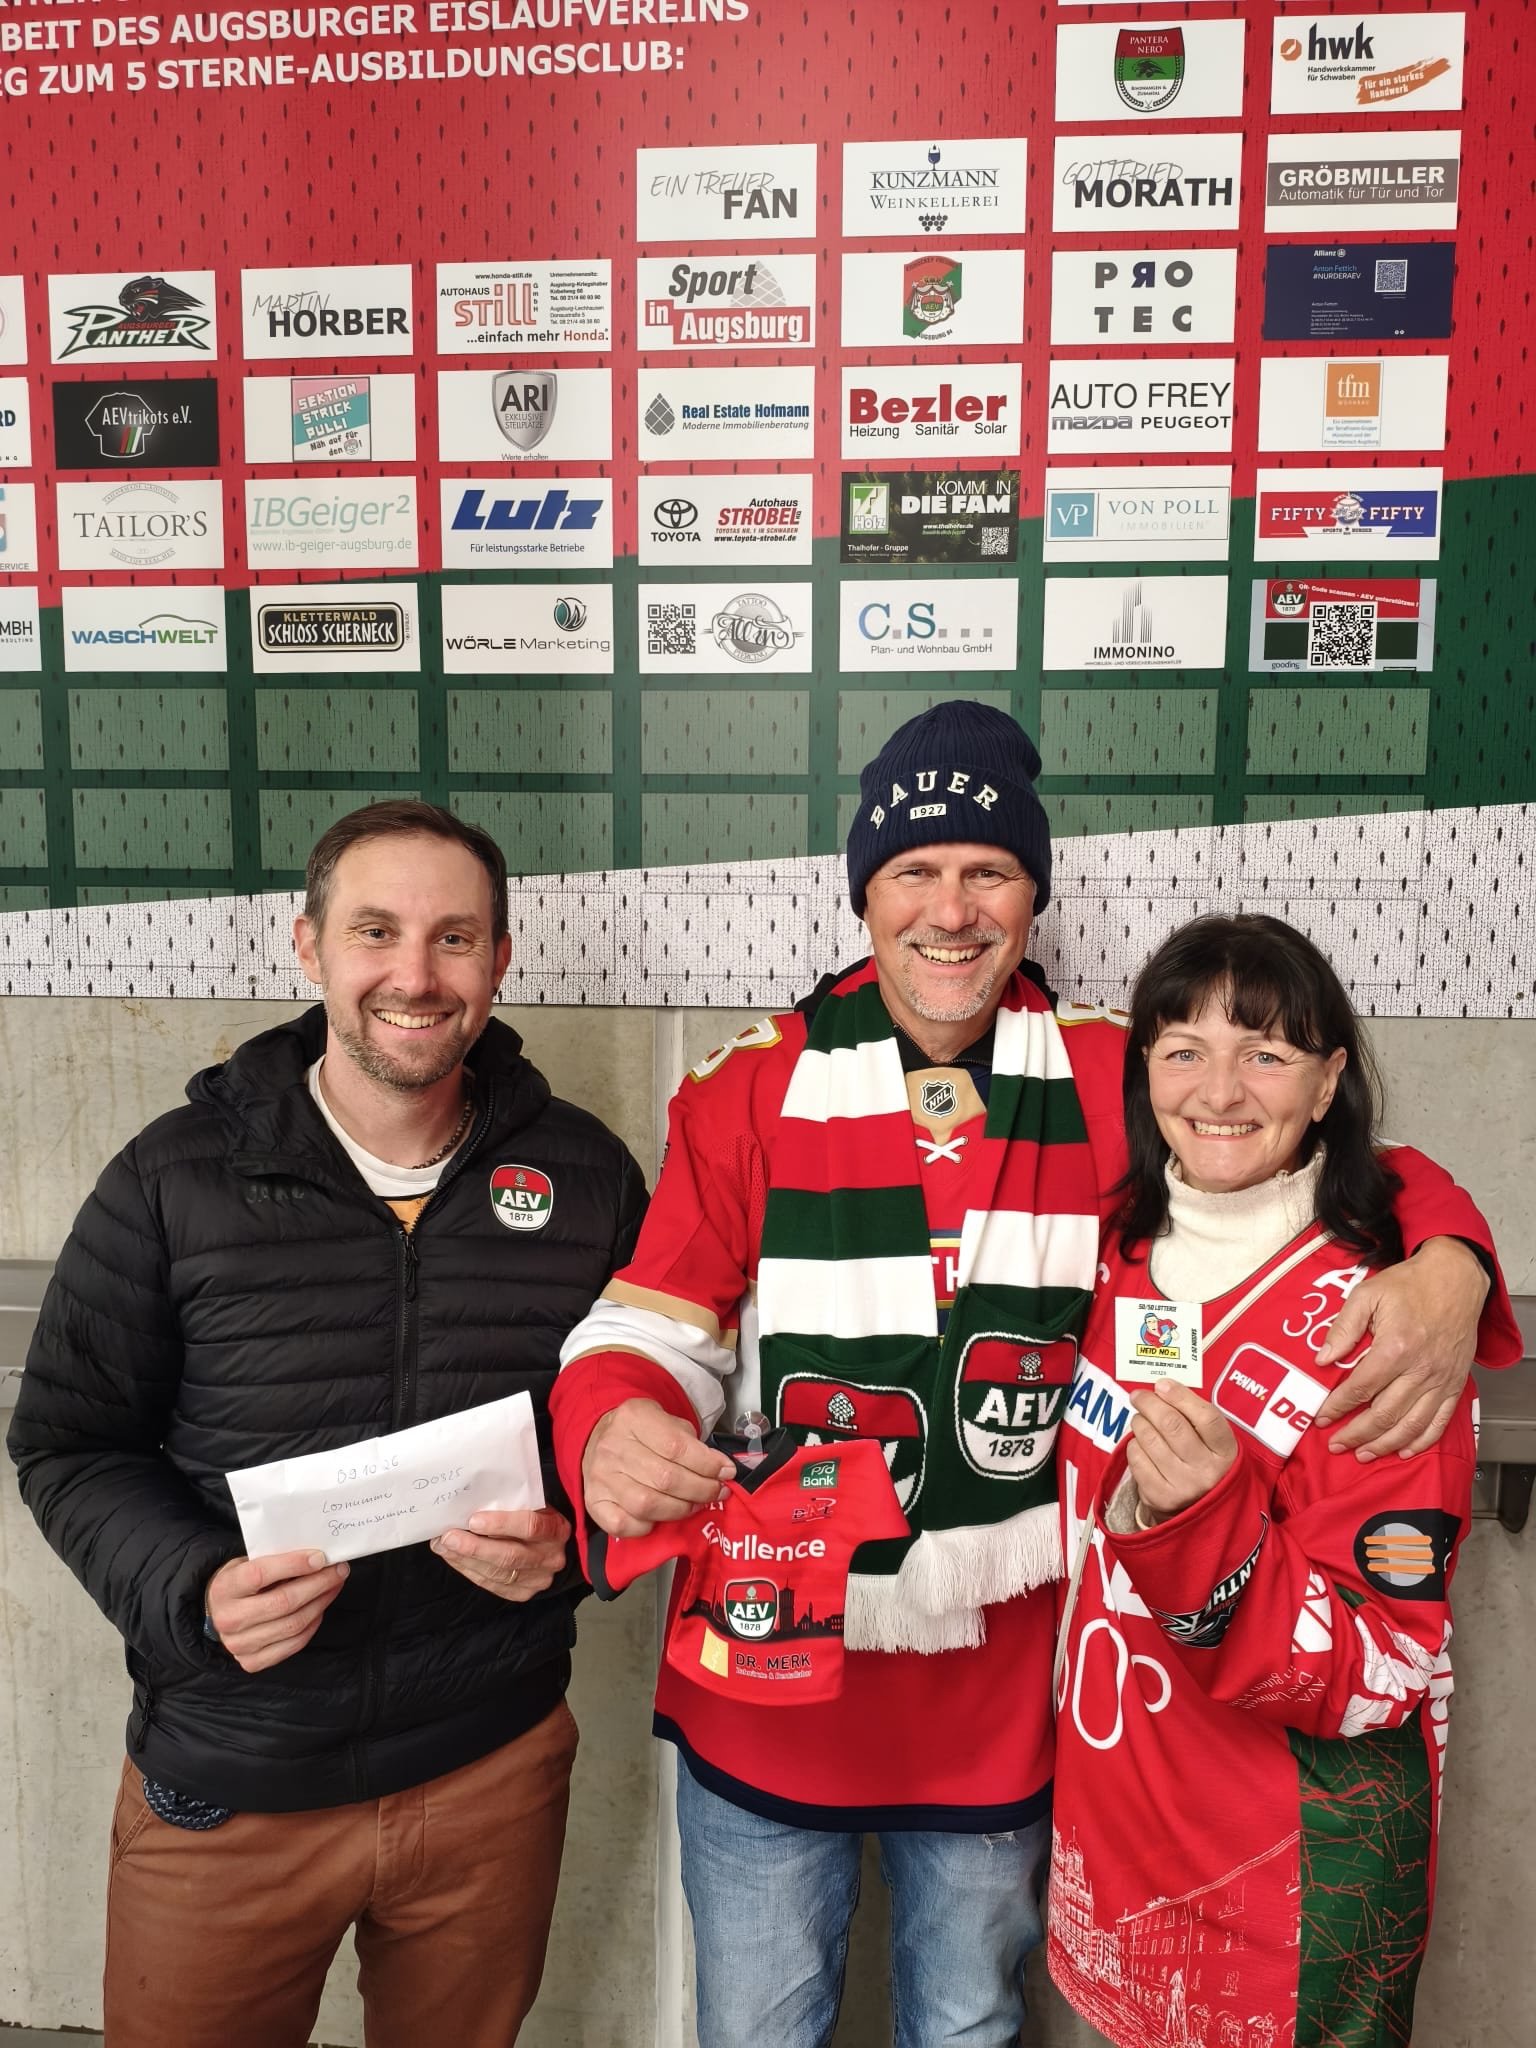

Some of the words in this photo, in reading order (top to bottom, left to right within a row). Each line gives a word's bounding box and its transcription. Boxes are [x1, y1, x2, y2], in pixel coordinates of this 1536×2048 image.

[92, 15, 161, 47] DES
[170, 6, 417, 44] AUGSBURGER
[430, 0, 748, 33] EISLAUFVEREINS
[1130, 35, 1169, 45] PANTERA
[1308, 22, 1374, 61] hwk
[1137, 45, 1163, 54] NERO
[39, 63, 114, 95] ZUM
[127, 61, 147, 91] 5
[157, 41, 686, 90] STERNE-AUSBILDUNGSCLUB:
[1308, 65, 1376, 73] Handwerkskammer
[1320, 73, 1355, 81] Schwaben
[1364, 79, 1377, 89] für
[1379, 77, 1391, 87] ein
[1393, 71, 1425, 84] starkes
[1370, 83, 1408, 99] Handwerk
[871, 170, 998, 189] KUNZMANN
[1062, 158, 1183, 186] GOTTFRIED
[1279, 164, 1444, 187] GRÖBMILLER
[650, 174, 686, 197] EIN
[695, 170, 775, 196] TREUER
[869, 193, 999, 209] WEINKELLEREI
[1075, 177, 1232, 209] MORATH
[1279, 187, 1343, 201] Automatik
[1347, 187, 1365, 199] für
[1369, 186, 1390, 199] Tür
[1395, 186, 1419, 198] und
[1424, 185, 1444, 198] Tor
[723, 188, 798, 220] FAN
[1314, 249, 1336, 257] Allianz
[668, 261, 758, 303] Sport
[1313, 272, 1361, 280] #NURDERAEV
[440, 287, 490, 297] AUTOHAUS
[252, 290, 330, 317] MARTIN
[269, 307, 410, 338] HORBER
[649, 301, 669, 325] in
[680, 310, 804, 343] Augsburg
[1094, 305, 1193, 333] TEC
[58, 305, 211, 359] PANTHER
[527, 331, 560, 342] mehr
[1337, 373, 1370, 398] tfm
[298, 383, 357, 410] SEKTION
[500, 384, 547, 411] ARI
[1050, 383, 1138, 410] AUTO
[1148, 382, 1231, 409] FREY
[302, 401, 352, 424] STRICK
[682, 404, 710, 419] Real
[714, 404, 751, 419] Estate
[755, 403, 810, 418] Hofmann
[849, 384, 1007, 425] Bezler
[102, 407, 169, 426] AEVtrikots
[172, 407, 192, 424] e.V.
[505, 413, 543, 421] EXKLUSIVE
[1140, 415, 1232, 429] PEUGEOT
[305, 417, 348, 439] PULLI
[682, 421, 719, 430] Moderne
[722, 420, 810, 431] Immobilienberatung
[849, 424, 900, 439] Heizung
[915, 422, 960, 436] Sanitär
[974, 421, 1007, 435] Solar
[310, 439, 326, 451] Näh
[345, 431, 358, 439] für
[328, 447, 343, 456] den
[936, 481, 985, 495] KOMM
[997, 481, 1011, 494] IN
[451, 489, 604, 530] Lutz
[749, 498, 798, 507] Autohaus
[901, 495, 947, 514] DIE
[951, 495, 1010, 514] FAM
[718, 508, 799, 525] STROBEL
[1056, 504, 1089, 526] VP
[1108, 500, 1154, 515] VON
[1164, 499, 1219, 514] POLL
[1271, 507, 1326, 521] FIFTY
[1370, 507, 1425, 520] FIFTY
[854, 515, 886, 529] Holz
[1120, 520, 1205, 531] IMMOBILIEN
[252, 538, 412, 553] www.ib-geiger-augsburg.de
[651, 532, 702, 542] TOYOTA
[714, 534, 796, 543] www.toyota-strobel.de
[470, 543, 484, 553] Für
[485, 543, 549, 555] leistungsstarke
[549, 543, 585, 553] Betriebe
[884, 545, 909, 553] Gruppe
[1277, 594, 1302, 604] AEV
[1360, 592, 1375, 601] AEV
[283, 611, 377, 622] KLETTERWALD
[71, 629, 218, 645] WASCHWELT
[268, 623, 319, 644] SCHLOSS
[322, 622, 395, 643] SCHERNECK
[445, 635, 516, 650] WÖRLE
[520, 637, 611, 653] Marketing
[871, 644, 895, 655] Plan-
[897, 644, 915, 654] und
[917, 643, 960, 654] Wohnbau
[962, 643, 993, 654] GmbH
[1094, 646, 1175, 659] IMMONINO
[1272, 660, 1300, 669] gooding
[870, 770, 999, 830] BAUER
[912, 805, 944, 817] 1927
[928, 1087, 950, 1110] NHL
[500, 1187, 542, 1210] AEV
[509, 1212, 534, 1222] 1878
[975, 1388, 1063, 1428] AEV
[988, 1436, 1035, 1458] 1878
[811, 1462, 836, 1476] psd
[803, 1475, 834, 1487] Bank
[732, 1602, 770, 1618] AEV
[740, 1622, 761, 1631] 1878
[736, 1653, 762, 1670] DR.
[767, 1652, 811, 1670] MERK
